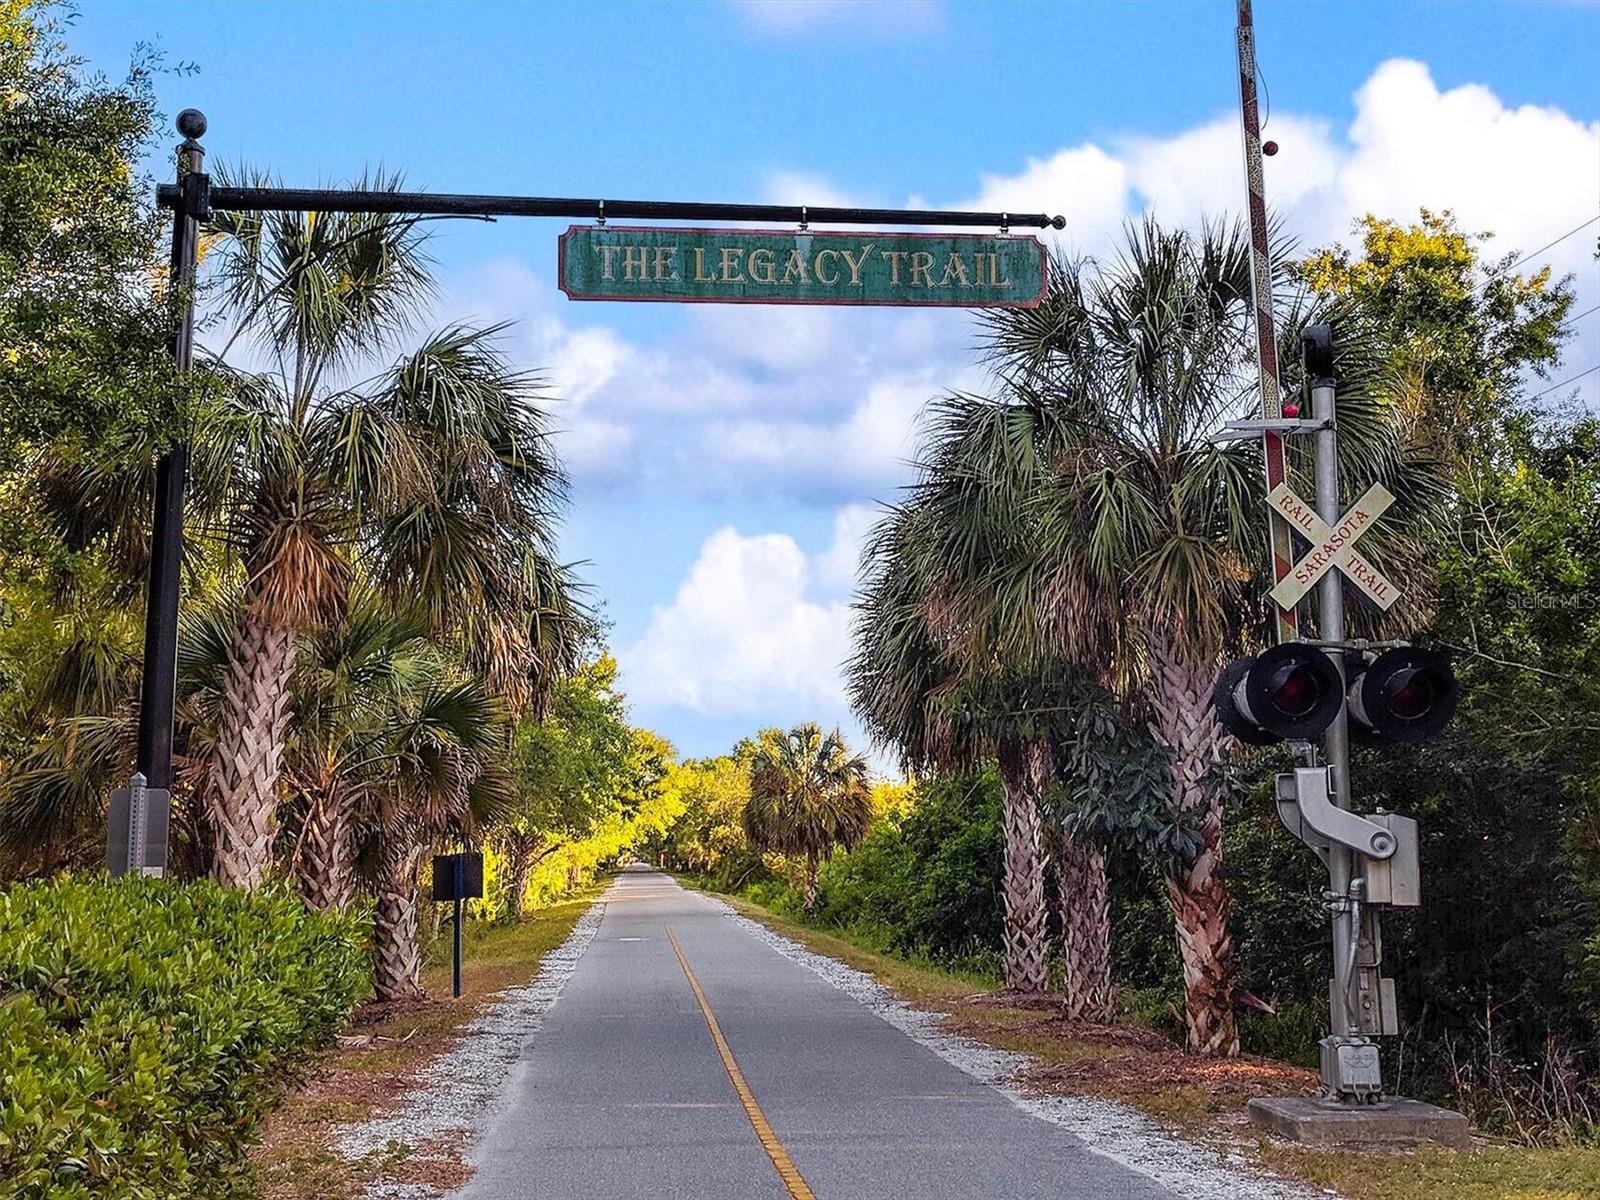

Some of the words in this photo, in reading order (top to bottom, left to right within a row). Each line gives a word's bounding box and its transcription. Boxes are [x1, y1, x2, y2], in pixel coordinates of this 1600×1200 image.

[594, 245, 683, 282] THE
[693, 243, 876, 286] LEGACY
[881, 251, 1013, 288] TRAIL
[1279, 495, 1315, 532] RAIL
[1295, 510, 1369, 584] SARASOTA
[1346, 555, 1389, 601] TRAIL
